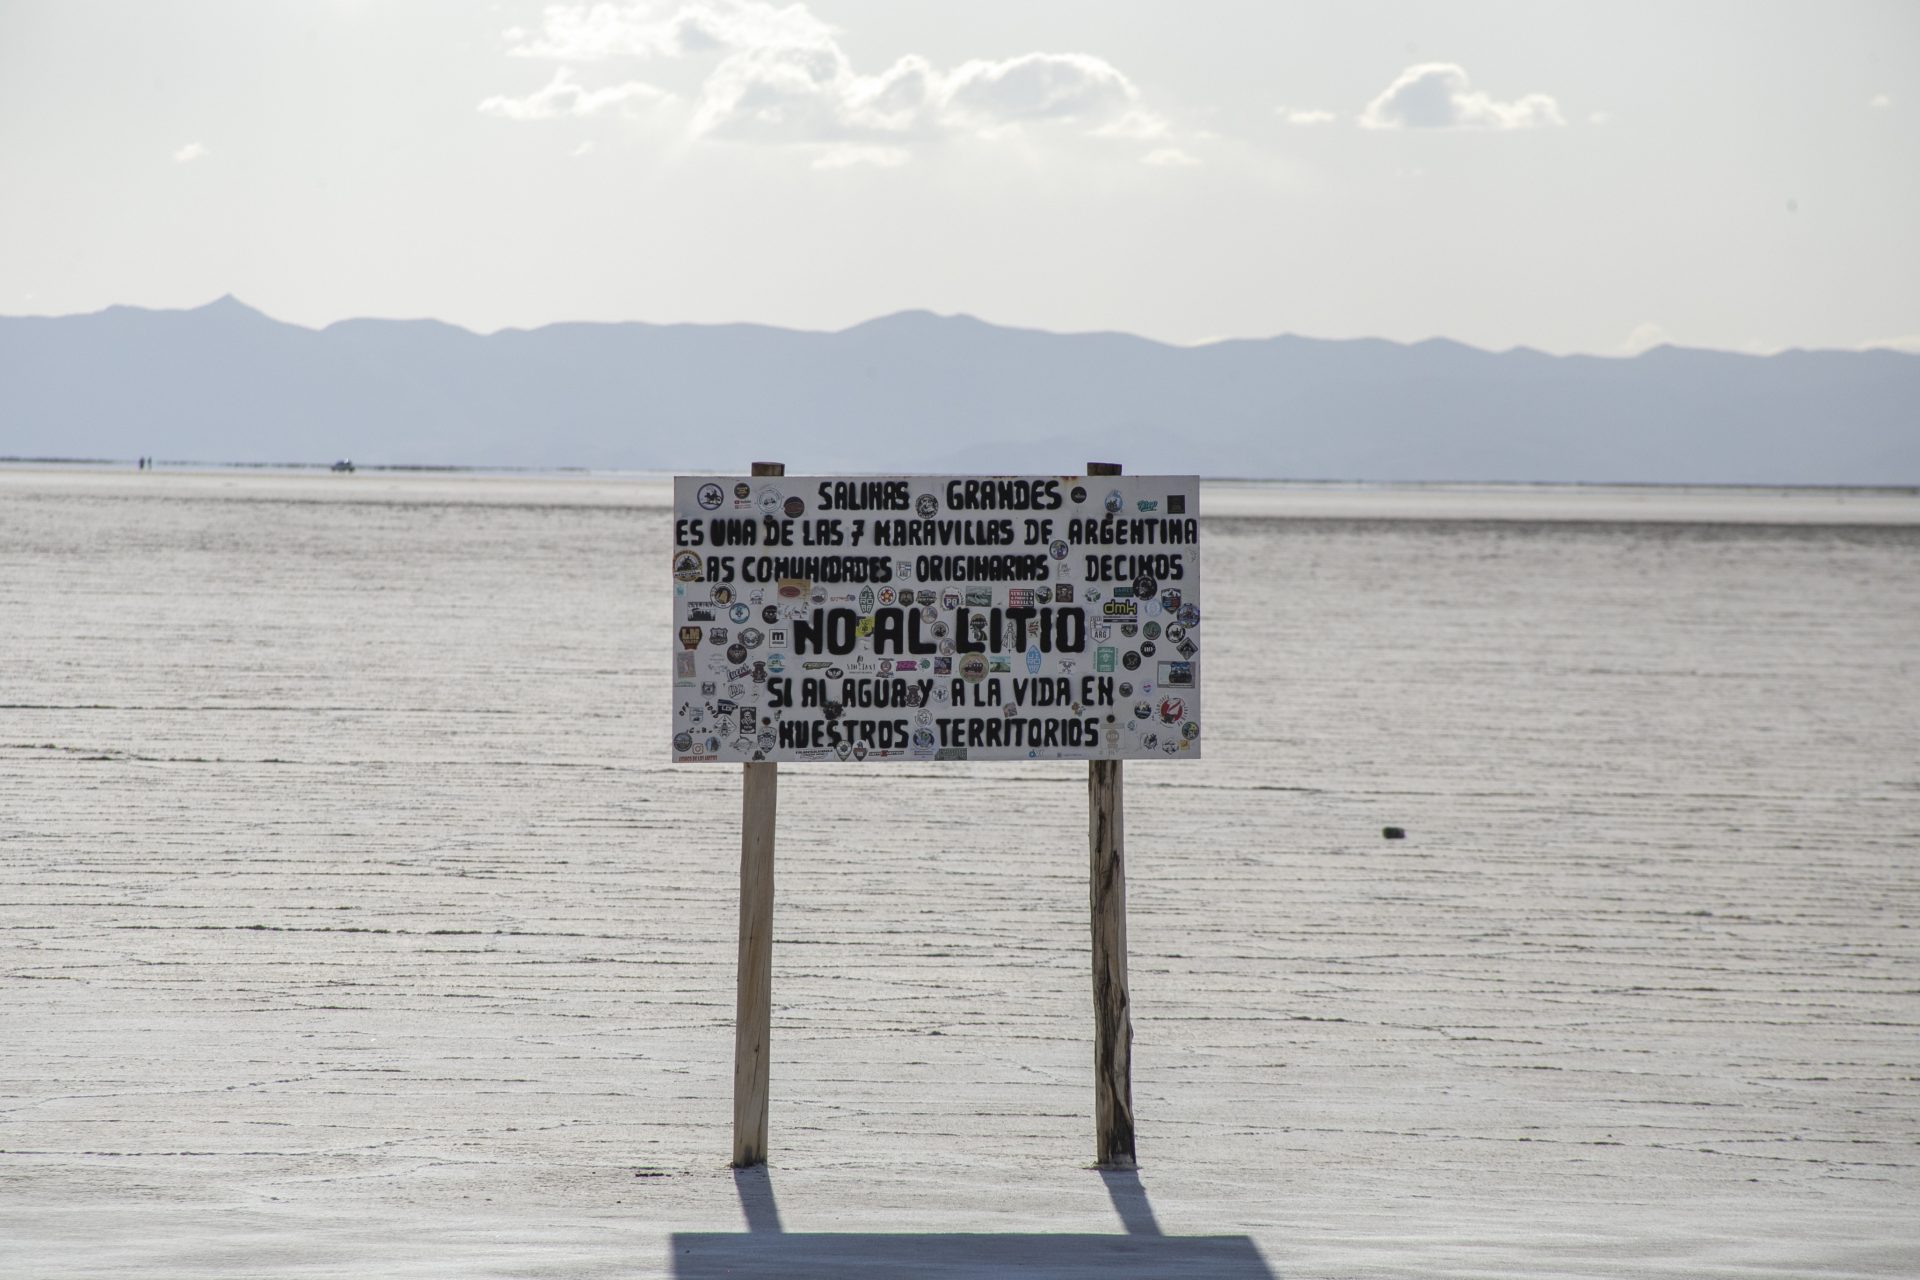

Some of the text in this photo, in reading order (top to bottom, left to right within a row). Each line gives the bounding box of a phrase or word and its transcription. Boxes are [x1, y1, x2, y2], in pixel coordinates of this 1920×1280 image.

[818, 480, 1063, 510] SALINAS GRANDES
[676, 518, 1198, 546] ES UNA DE LAS 7 MARAVILLAS DE ARGENTINA
[694, 556, 735, 582] AS
[742, 556, 892, 583] COMUNIDADES
[916, 554, 1049, 582] ORIGINARIAS
[1085, 554, 1183, 581] DECIMOS
[1103, 599, 1137, 615] dmk
[793, 607, 1085, 655] NO AL LITIO
[1094, 630, 1107, 639] ARG
[767, 677, 793, 708] SI
[802, 678, 829, 708] AL
[842, 678, 908, 707] AGUA
[917, 678, 934, 708] Y
[951, 677, 966, 706] A
[974, 677, 1002, 706] LA
[1013, 677, 1071, 706] VIDA
[1081, 675, 1114, 706] EN
[779, 718, 1099, 749] NUESTROS TERRITORIOS
